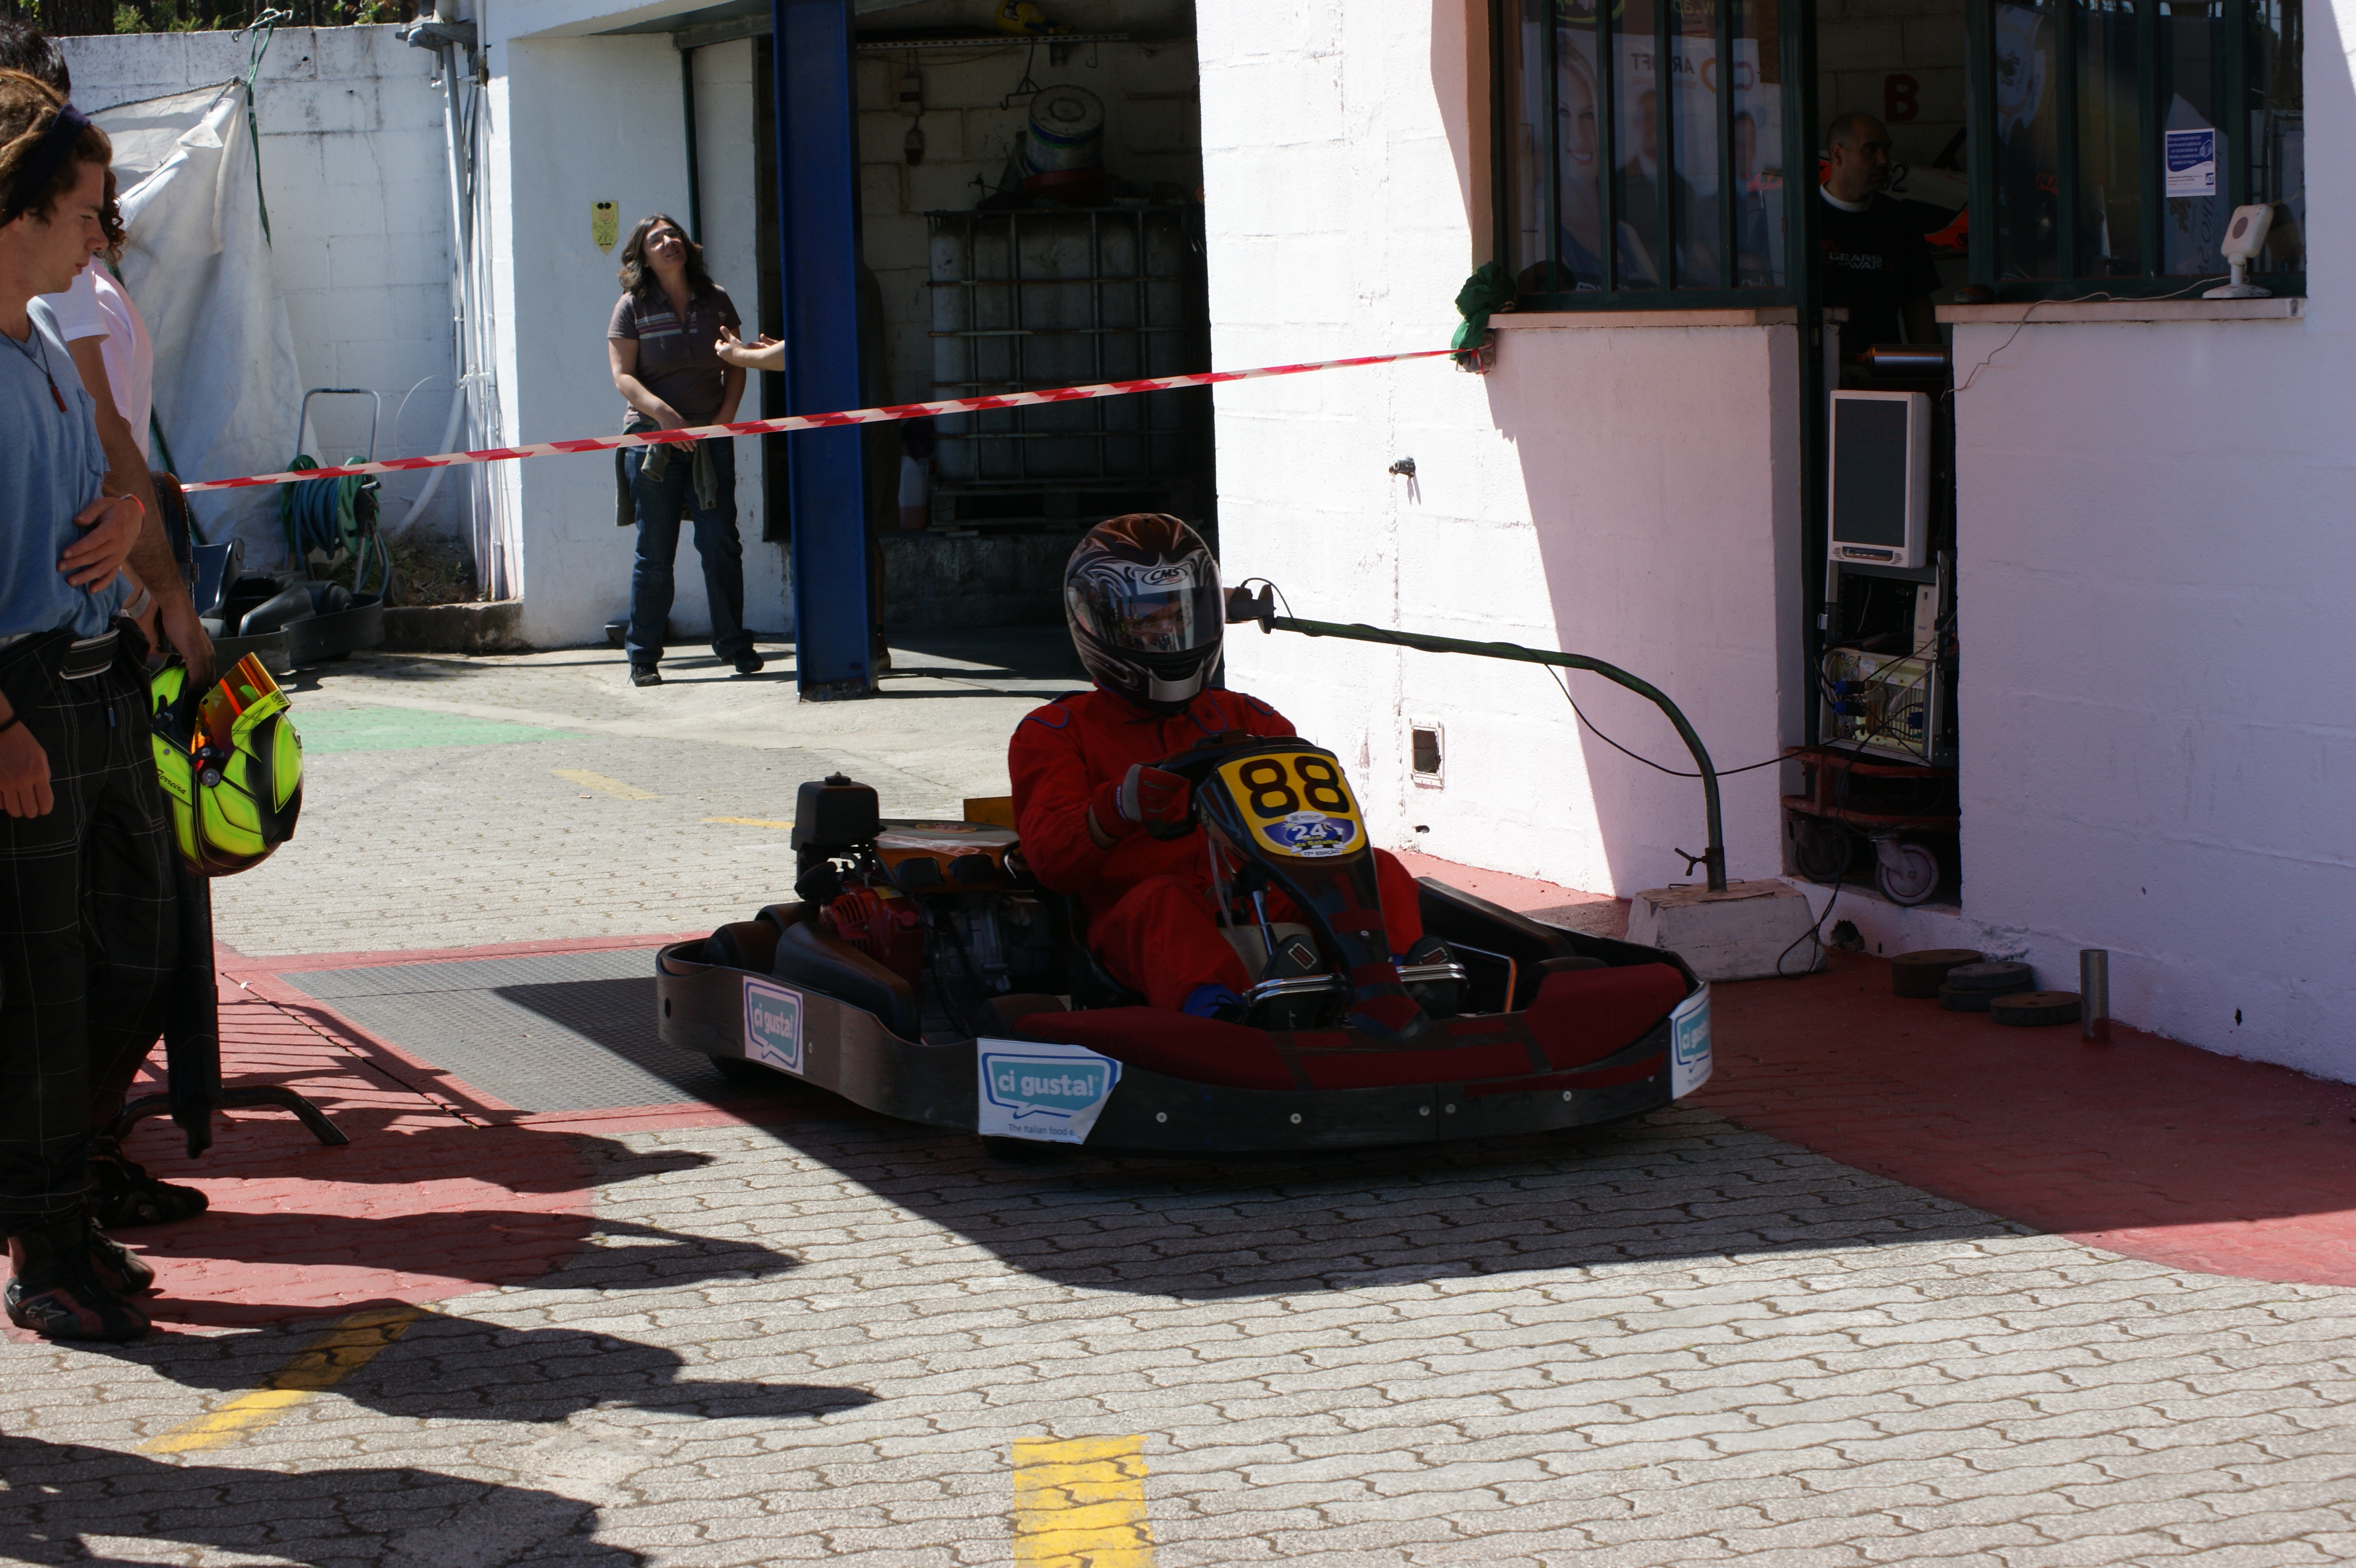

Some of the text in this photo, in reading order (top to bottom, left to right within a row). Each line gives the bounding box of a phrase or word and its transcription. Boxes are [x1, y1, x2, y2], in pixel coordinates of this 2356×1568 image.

[1884, 73, 1919, 122] B
[1829, 252, 1883, 263] GEARS
[1848, 261, 1882, 269] WAR
[1150, 567, 1180, 581] CMS
[1239, 756, 1350, 819] 88
[1291, 824, 1328, 840] 24
[754, 1003, 794, 1039] ci gusta!
[1682, 1027, 1691, 1050] ci
[997, 1069, 1094, 1096] ci gusta!
[1008, 1124, 1022, 1132] The
[1024, 1125, 1047, 1134] Italian
[1049, 1126, 1068, 1135] food
